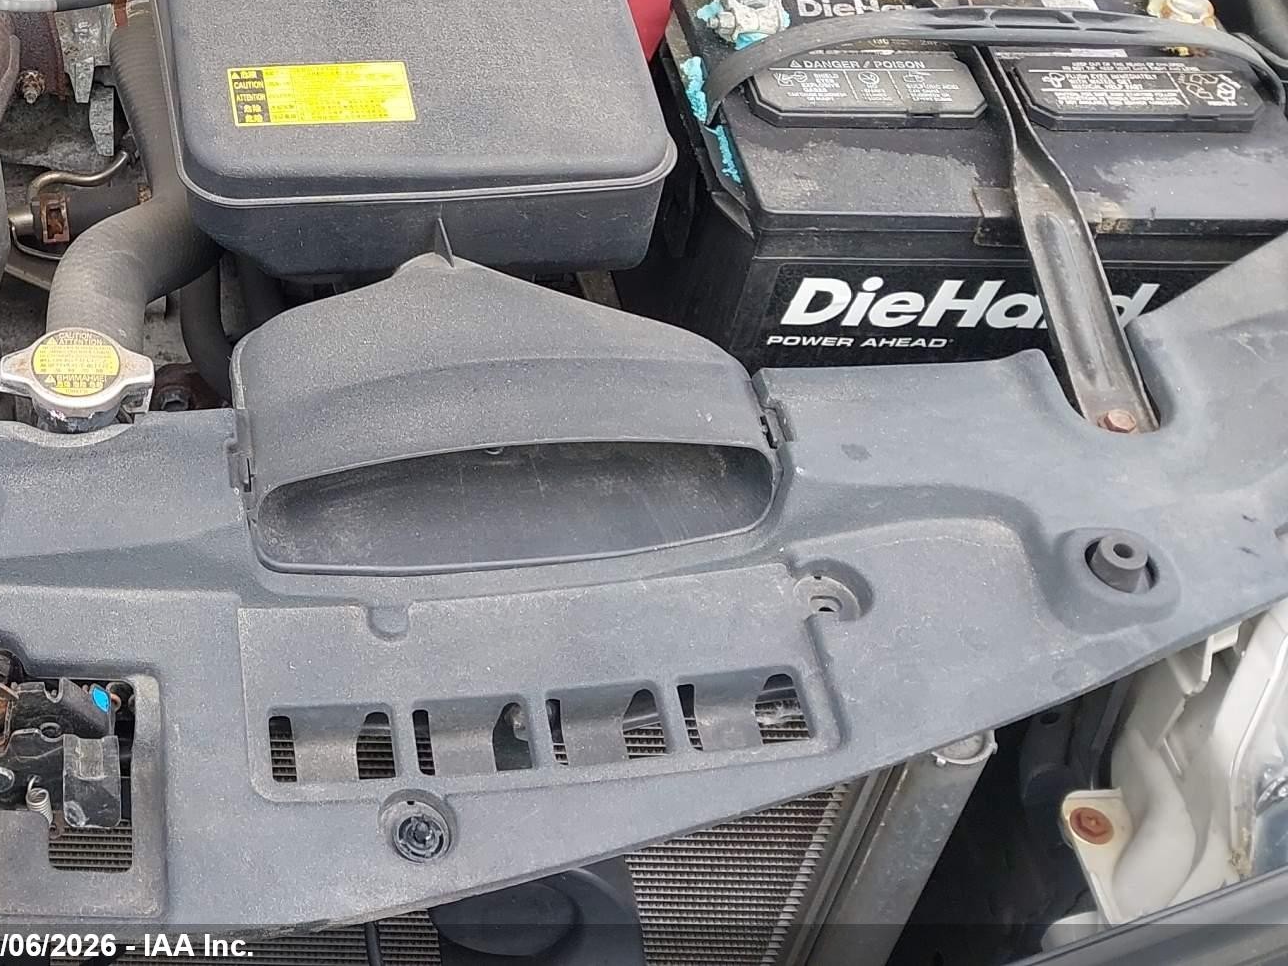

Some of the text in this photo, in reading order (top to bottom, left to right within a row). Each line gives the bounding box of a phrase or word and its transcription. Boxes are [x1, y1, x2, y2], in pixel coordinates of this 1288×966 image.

[802, 60, 861, 69] DANGER
[873, 60, 926, 69] POISON
[233, 80, 265, 90] CAUTION
[236, 93, 267, 103] ATTENTION
[780, 276, 1160, 329] DieHad
[58, 332, 93, 340] CAUTION
[58, 338, 103, 346] ATTENTION
[767, 336, 949, 348] POWER AHEAD
